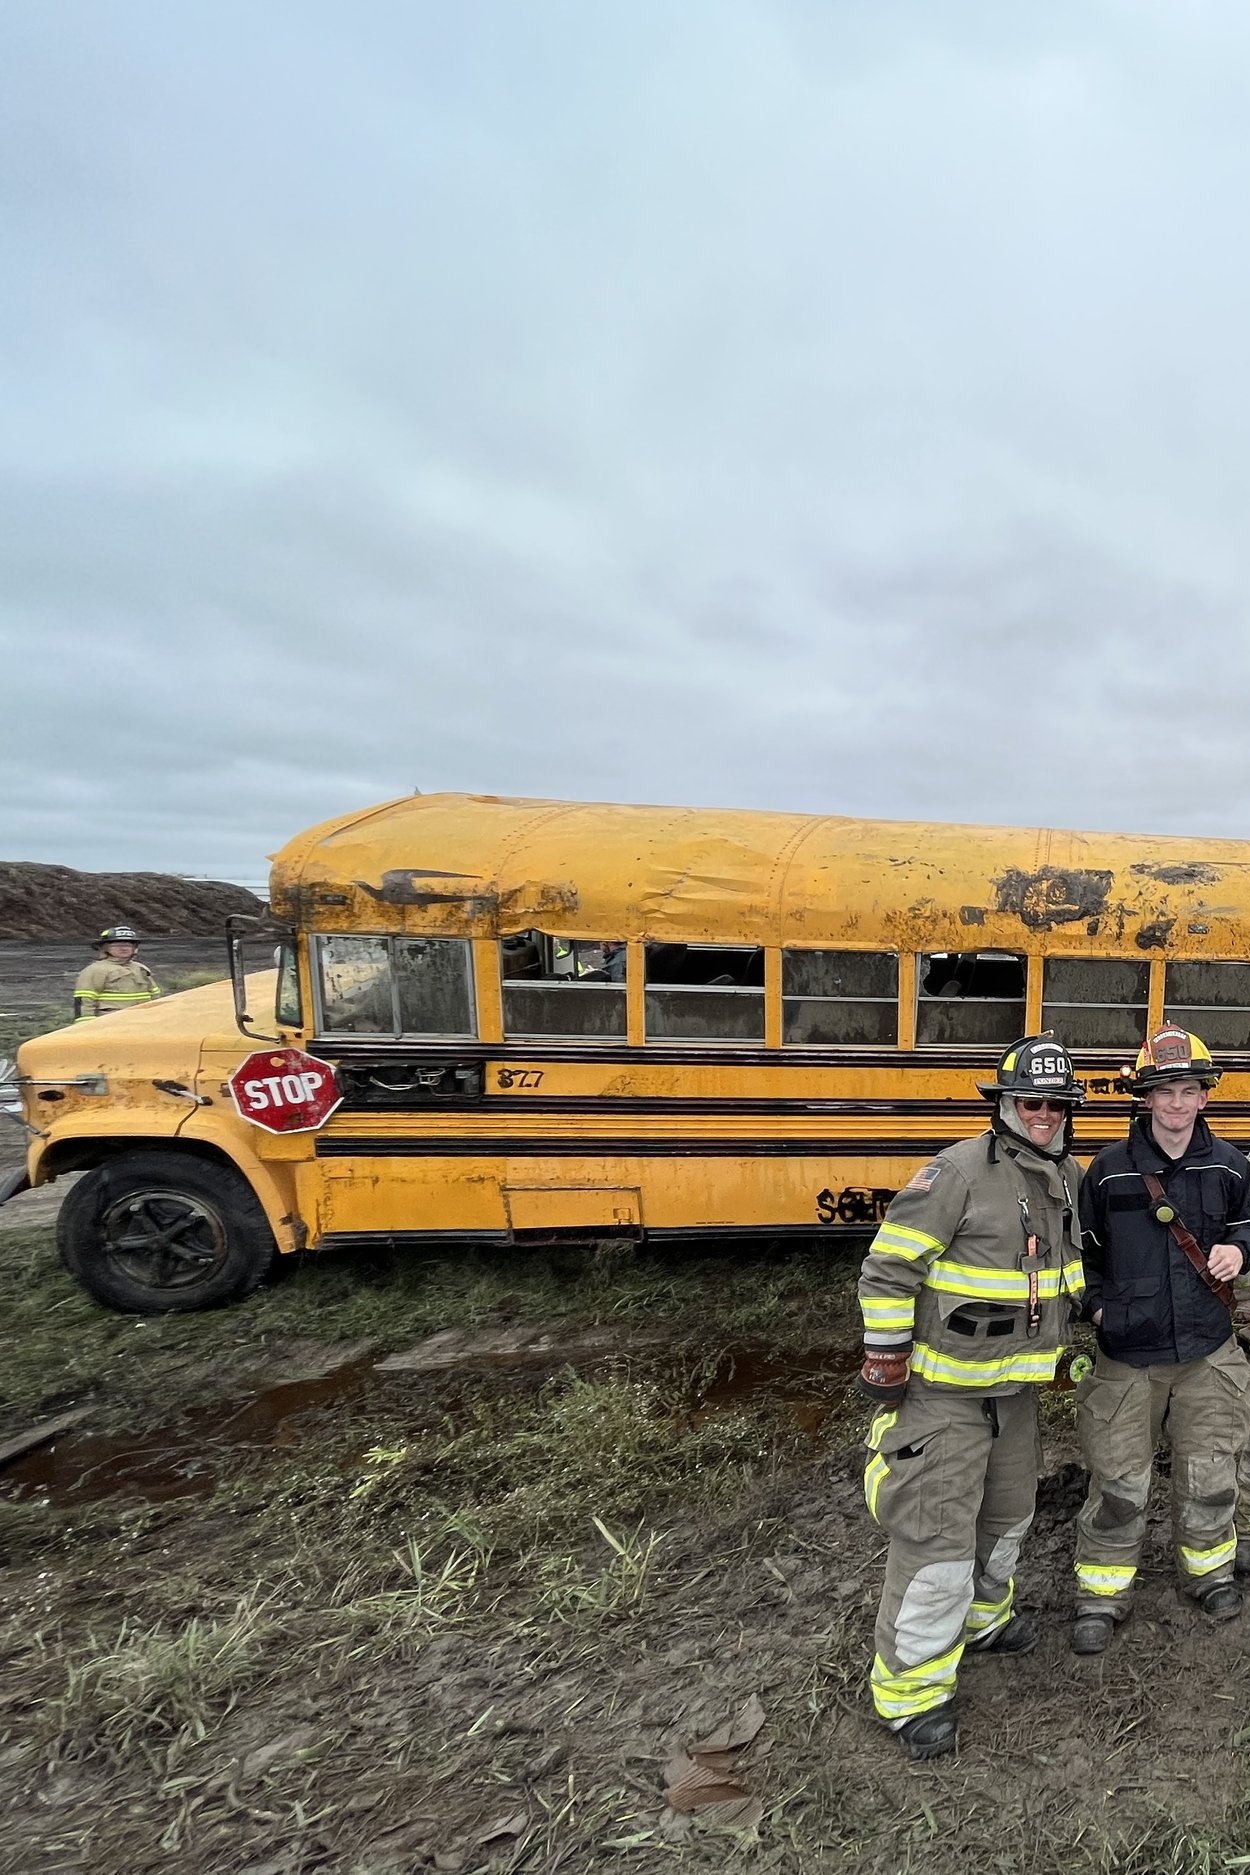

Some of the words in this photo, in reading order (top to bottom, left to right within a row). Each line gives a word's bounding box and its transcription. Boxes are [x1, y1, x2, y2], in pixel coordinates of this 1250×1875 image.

[1156, 1045, 1190, 1063] 650
[1031, 1057, 1066, 1075] 650
[244, 1071, 323, 1110] STOP
